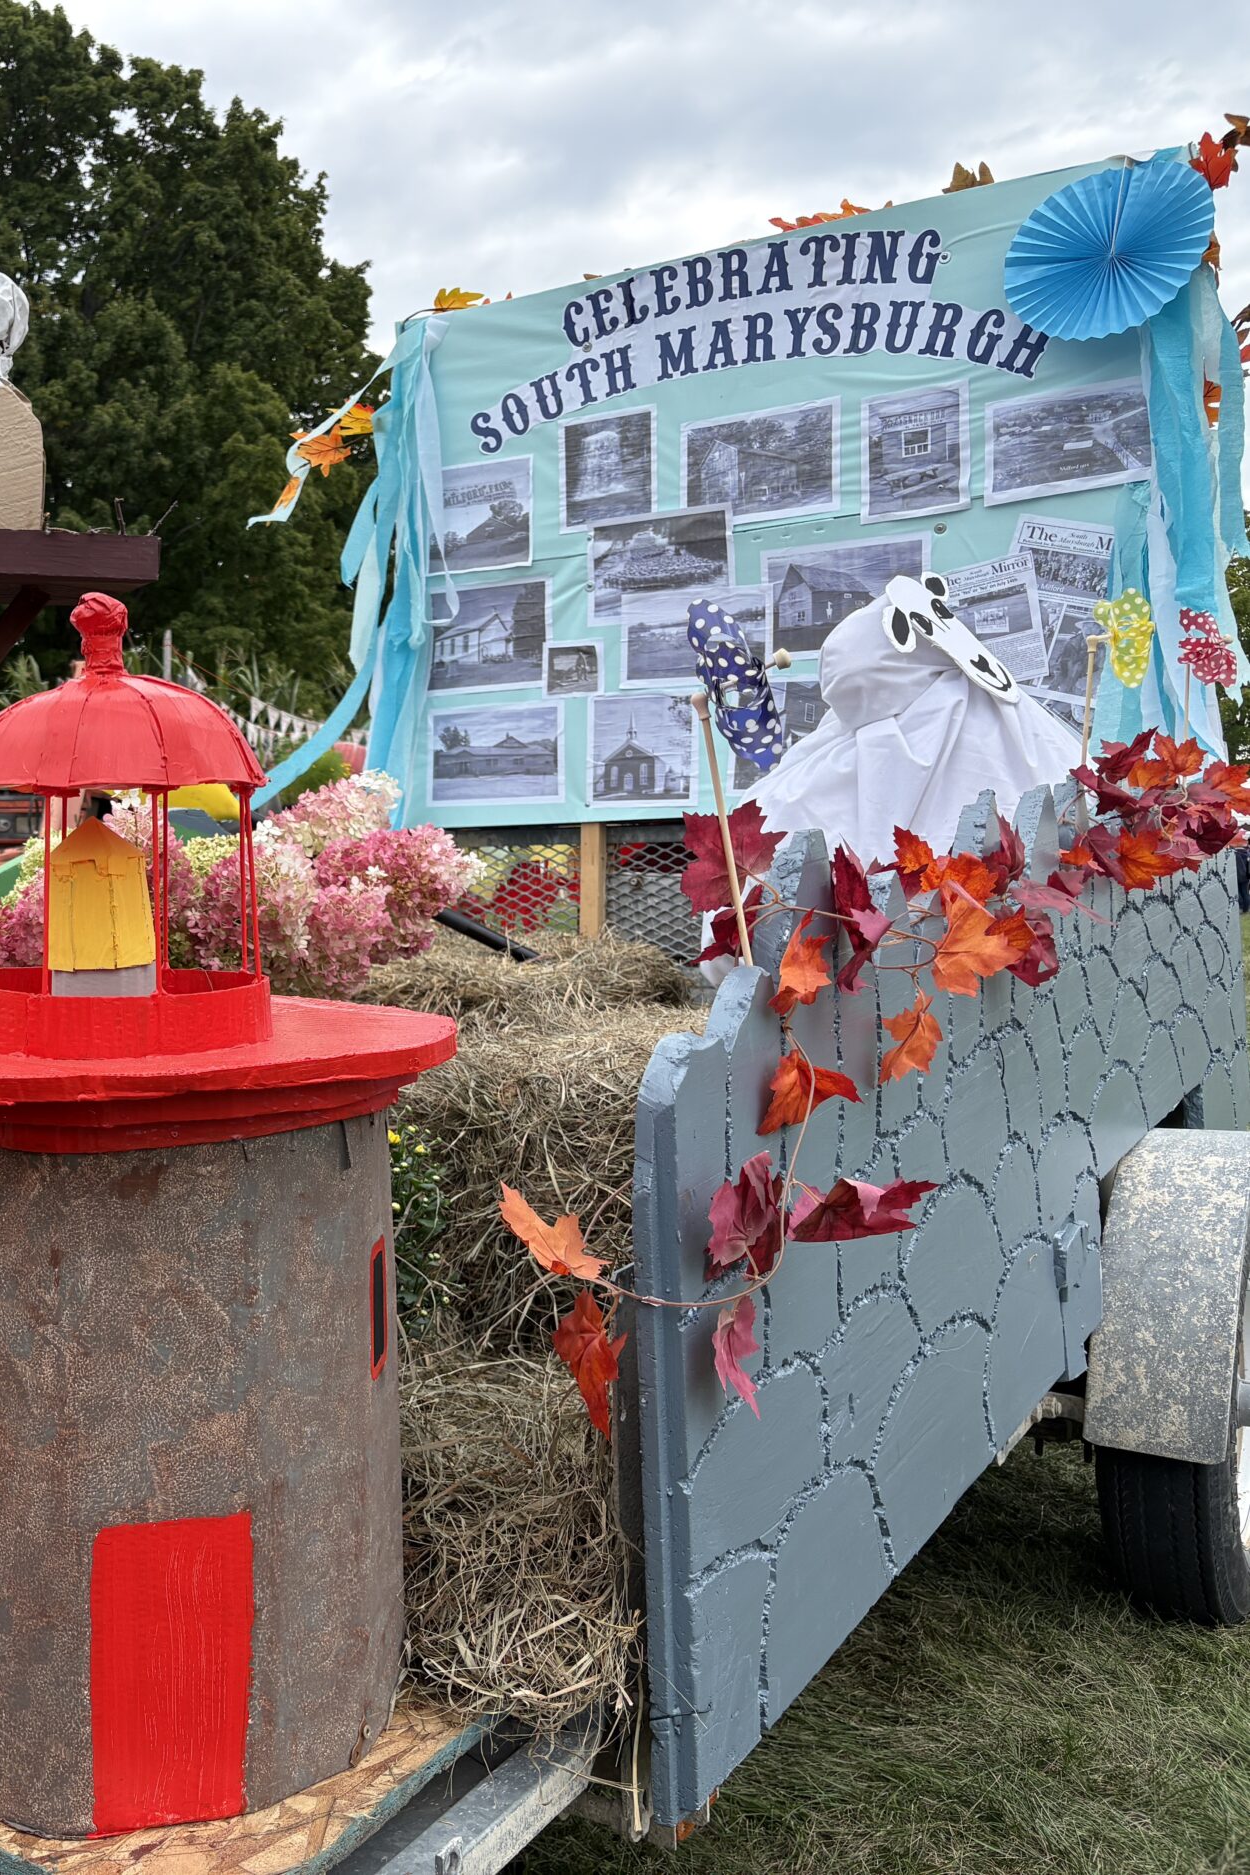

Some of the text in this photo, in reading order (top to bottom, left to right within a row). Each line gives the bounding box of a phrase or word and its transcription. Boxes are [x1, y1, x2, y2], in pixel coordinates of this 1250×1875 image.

[562, 229, 942, 348] CELEBRATING
[470, 300, 1050, 454] SOUTH MARYSBURGH
[1026, 525, 1058, 543] The
[1059, 536, 1095, 548] Marysburgh
[1070, 532, 1088, 540] South
[944, 576, 961, 587] he
[991, 559, 1029, 576] Mirror
[1040, 583, 1065, 593] Milford
